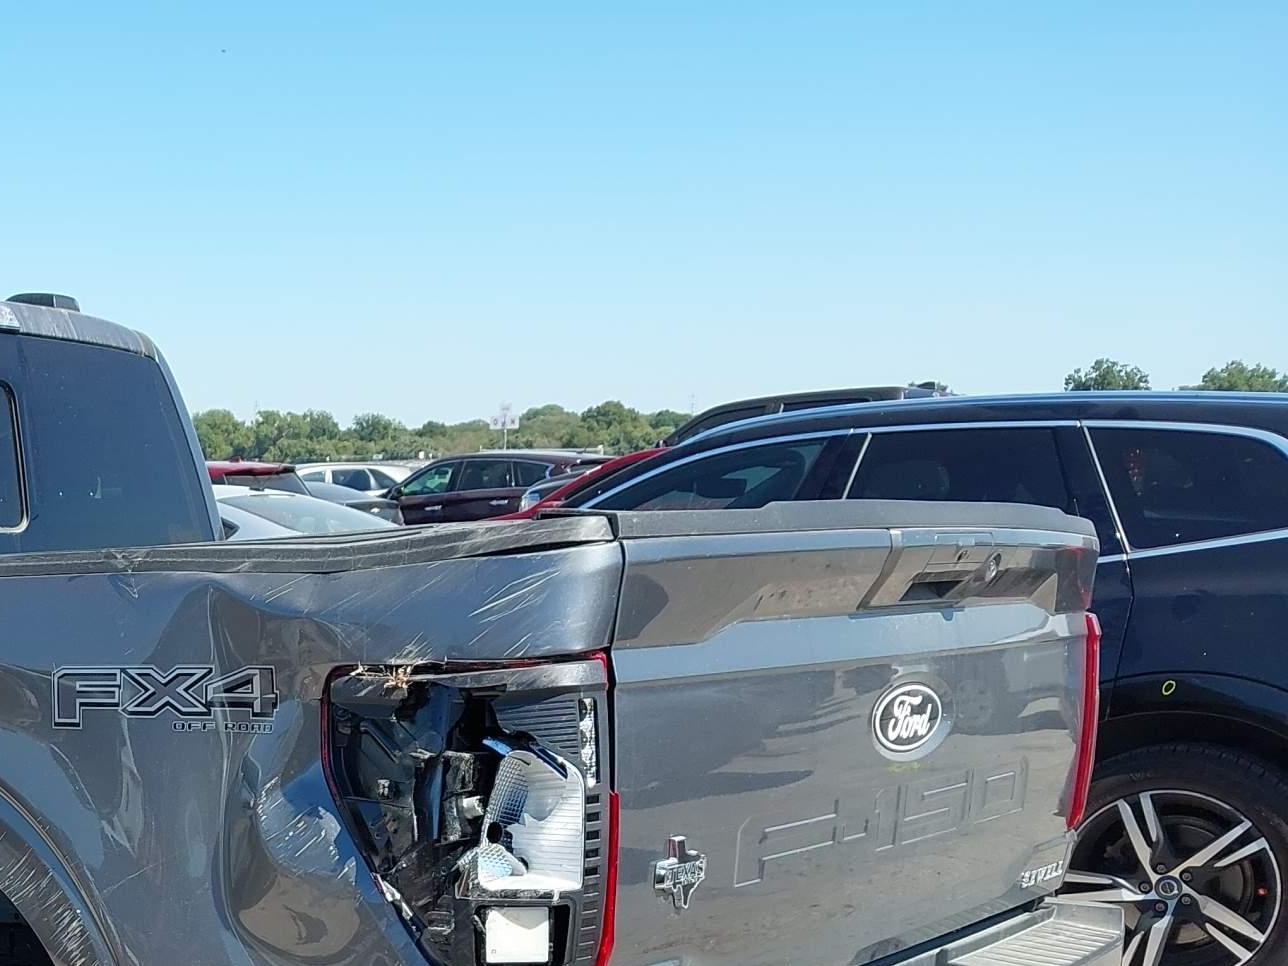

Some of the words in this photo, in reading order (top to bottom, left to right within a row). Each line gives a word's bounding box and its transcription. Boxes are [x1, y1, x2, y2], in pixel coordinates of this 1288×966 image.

[52, 665, 279, 729] FX4
[887, 695, 932, 741] Ford
[172, 720, 216, 732] OFF
[224, 721, 273, 734] ROAD
[734, 757, 1029, 888] F-150
[671, 860, 705, 882] TEXAS
